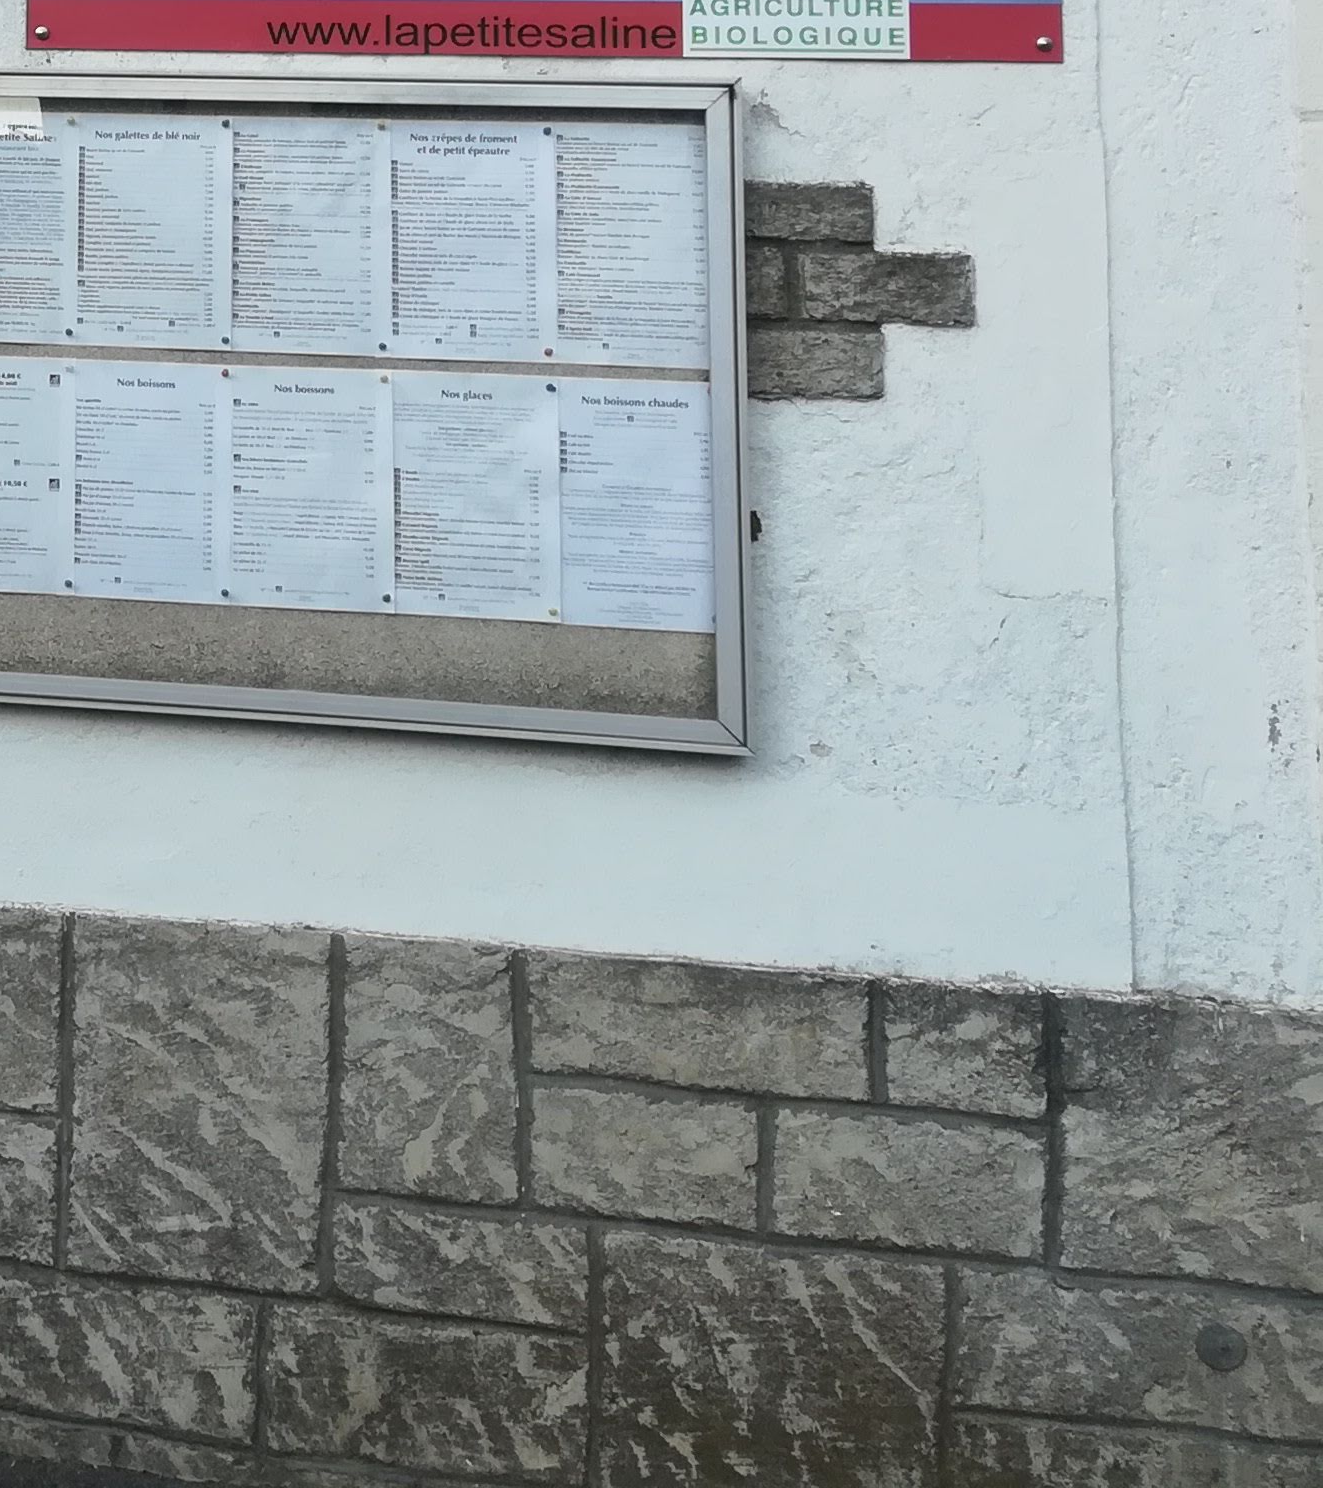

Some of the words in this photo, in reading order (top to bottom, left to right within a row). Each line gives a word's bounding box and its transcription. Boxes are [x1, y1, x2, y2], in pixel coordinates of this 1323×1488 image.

[691, 26, 905, 46] BIOLOGIQUE
[95, 130, 113, 139] Nos
[115, 130, 150, 141] galettes
[152, 130, 164, 140] de
[410, 133, 429, 142] Nos
[465, 133, 476, 143] de
[429, 145, 441, 155] de
[116, 378, 135, 387] Nos
[274, 384, 293, 393] Nos
[441, 390, 460, 399] Nos
[581, 396, 601, 405] Nos
[604, 396, 646, 407] boissons
[648, 398, 689, 409] chaudes
